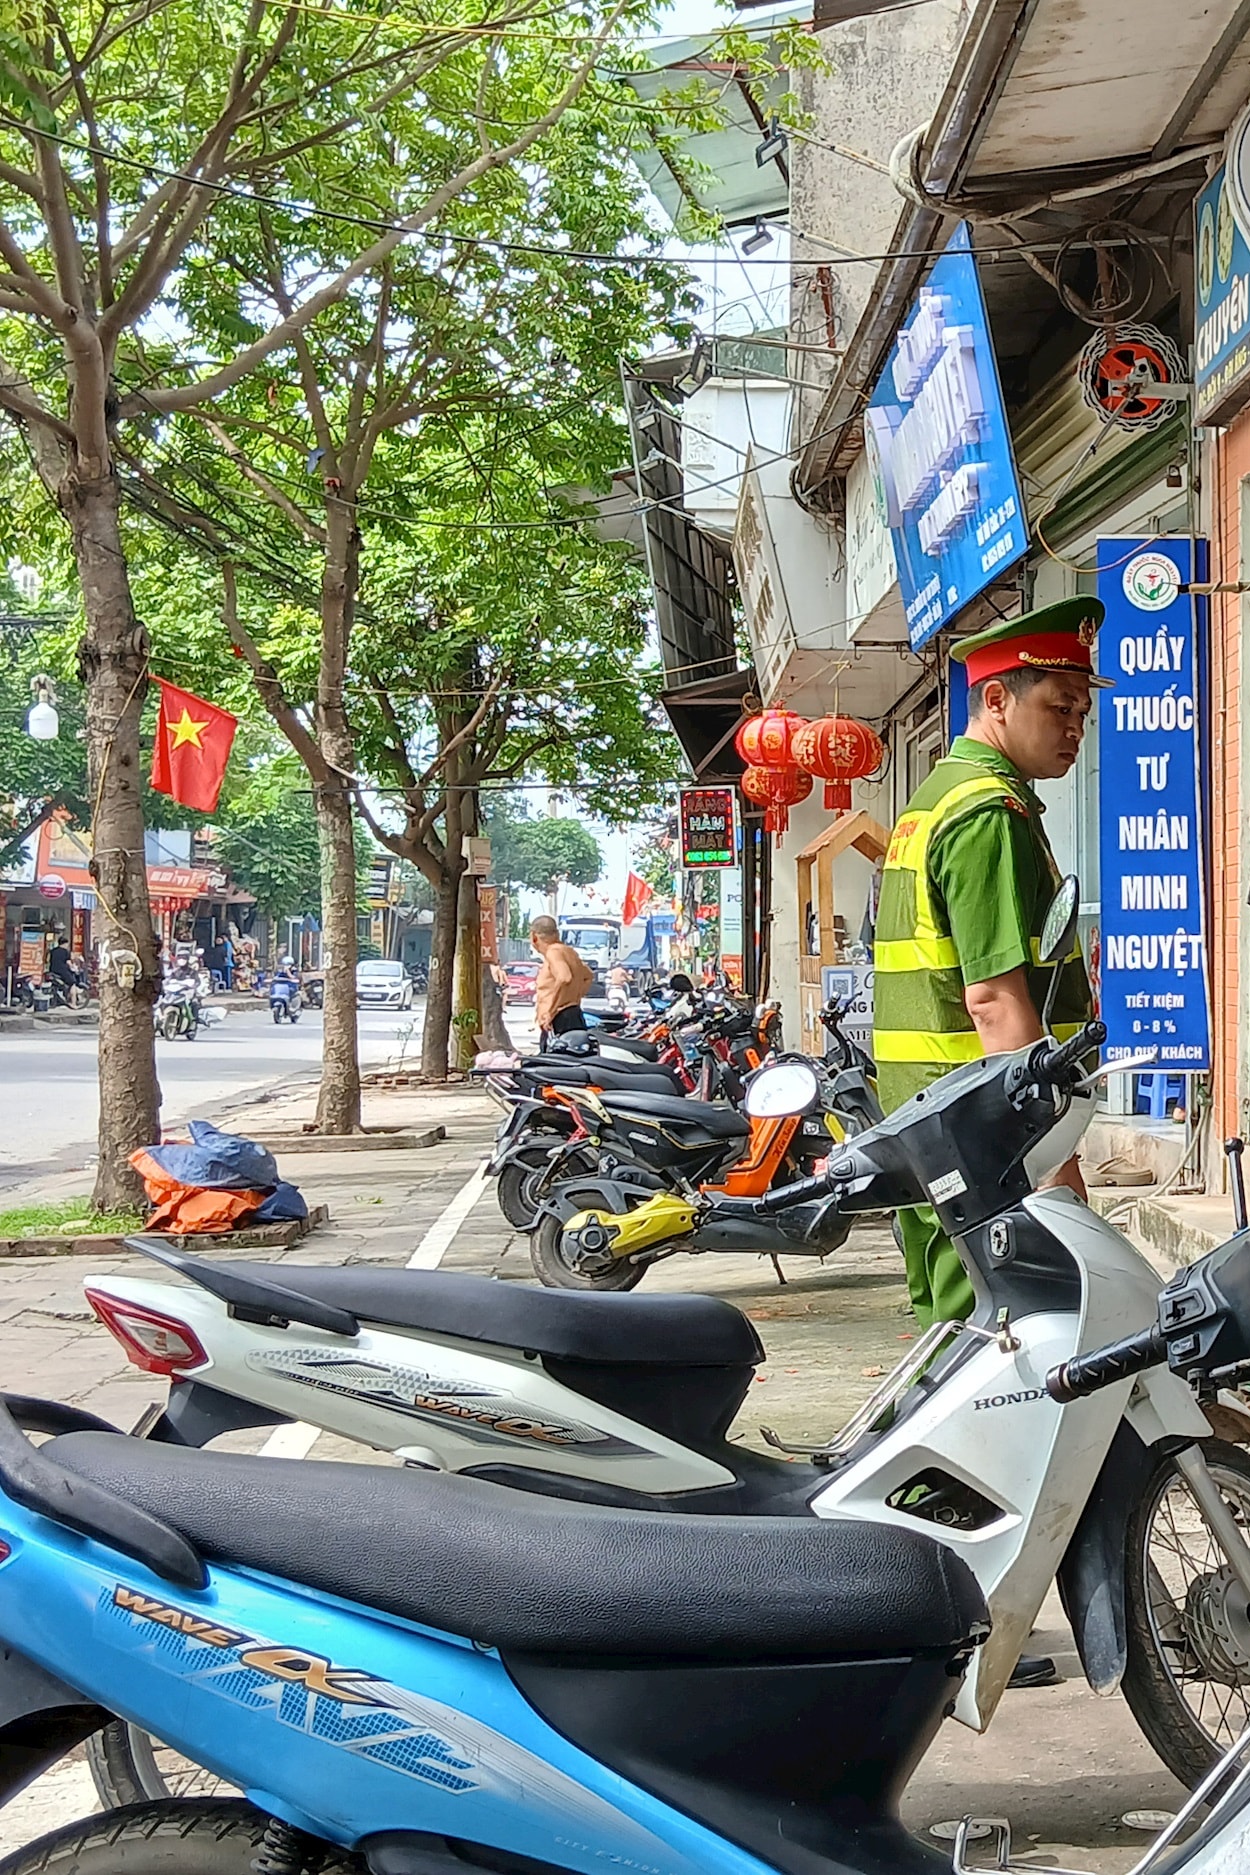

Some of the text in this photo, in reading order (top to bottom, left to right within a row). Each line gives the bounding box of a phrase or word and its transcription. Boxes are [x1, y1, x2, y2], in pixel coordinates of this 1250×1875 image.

[1196, 274, 1250, 371] CHUYÊN
[1119, 624, 1185, 676] QUẦY
[1113, 683, 1194, 732] THUỐC
[1136, 752, 1170, 791] TƯ
[689, 812, 726, 832] HÀM
[1118, 808, 1189, 850] NHÂN
[1120, 875, 1188, 910] MINH
[1106, 927, 1203, 977] NGUYỆT
[1124, 990, 1185, 1011] TIẾT KIỆM
[1152, 1020, 1161, 1033] 8
[1163, 1020, 1177, 1033] %
[1106, 1046, 1132, 1060] CHO
[1161, 1043, 1203, 1060] KHÁCH
[414, 1394, 498, 1424] WAVE
[974, 1388, 1051, 1412] HONDA
[114, 1584, 245, 1648] WAVE
